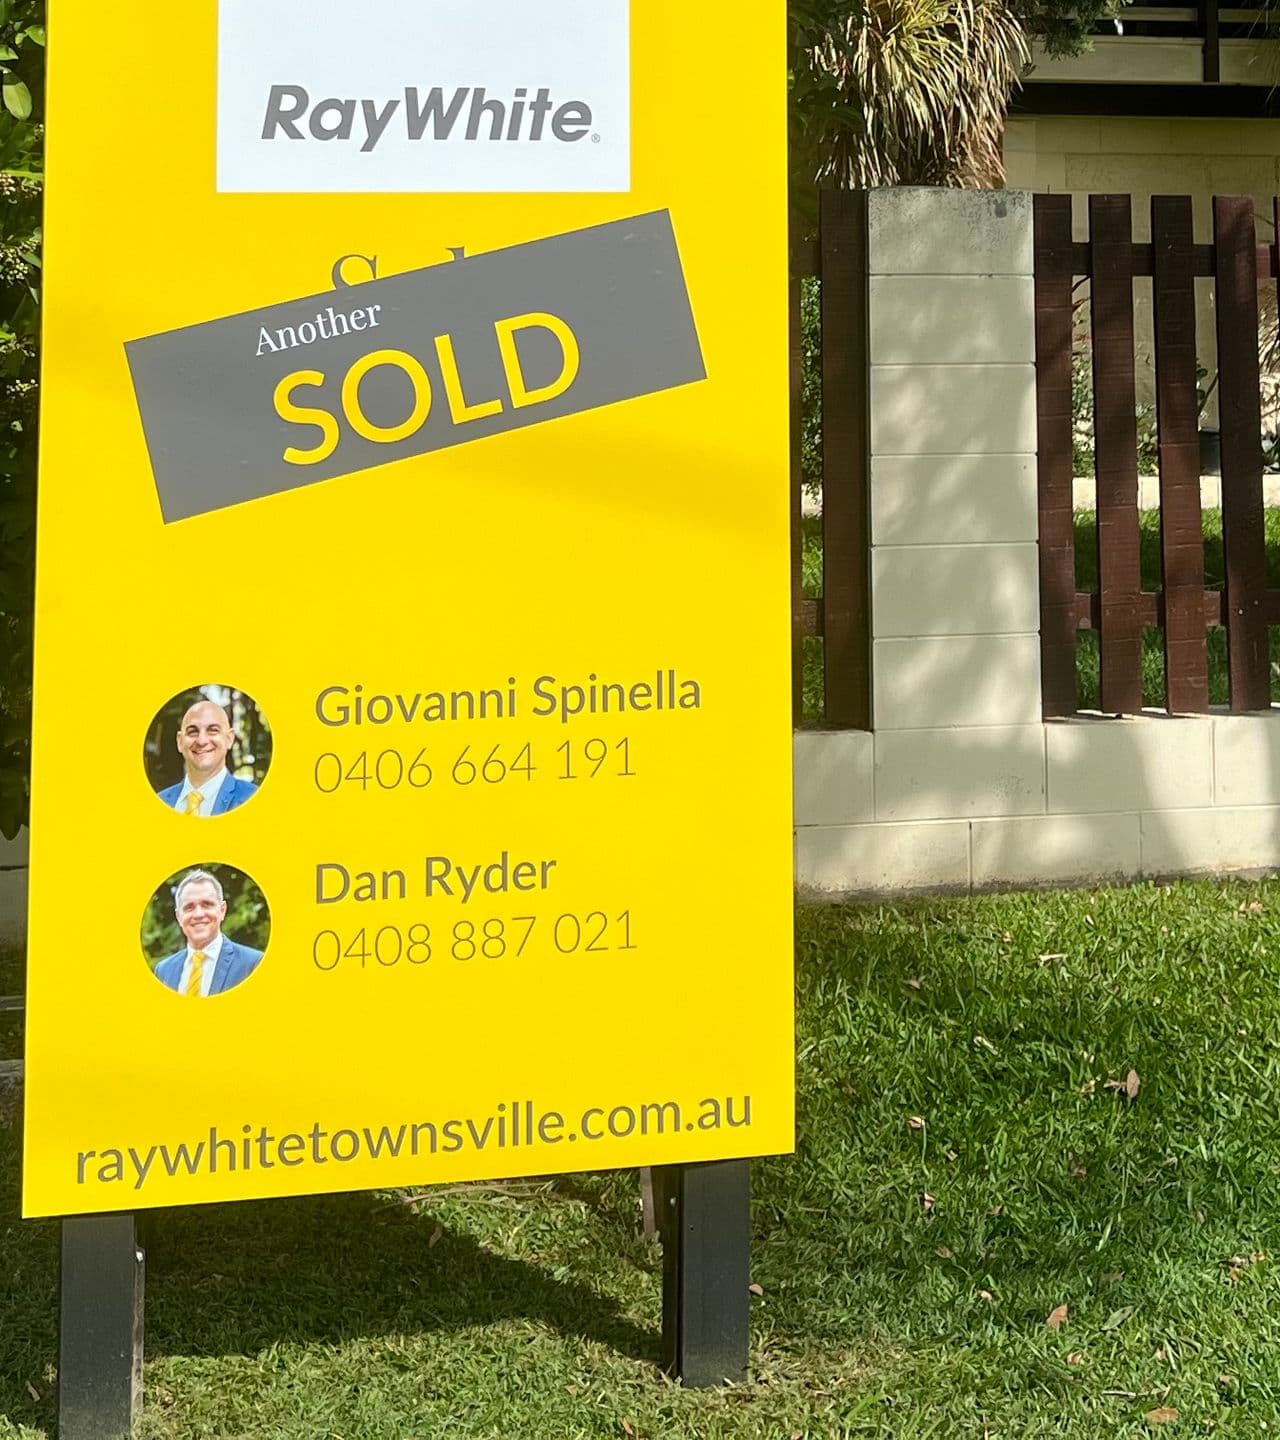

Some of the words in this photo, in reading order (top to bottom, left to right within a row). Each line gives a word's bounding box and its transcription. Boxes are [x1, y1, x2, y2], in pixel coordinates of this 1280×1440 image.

[255, 303, 381, 356] Another
[273, 312, 580, 465] SOLD
[315, 677, 517, 728] Giovanni
[532, 669, 702, 723] Spinella
[314, 747, 433, 794] 0406
[451, 742, 538, 787] 664
[557, 736, 637, 780] 191
[315, 863, 406, 905] Dan
[425, 851, 557, 905] Ryder
[312, 924, 432, 971] 0408
[451, 916, 537, 961] 887
[554, 910, 638, 954] 021
[77, 1095, 752, 1190] raywhitetownsville.com.au
